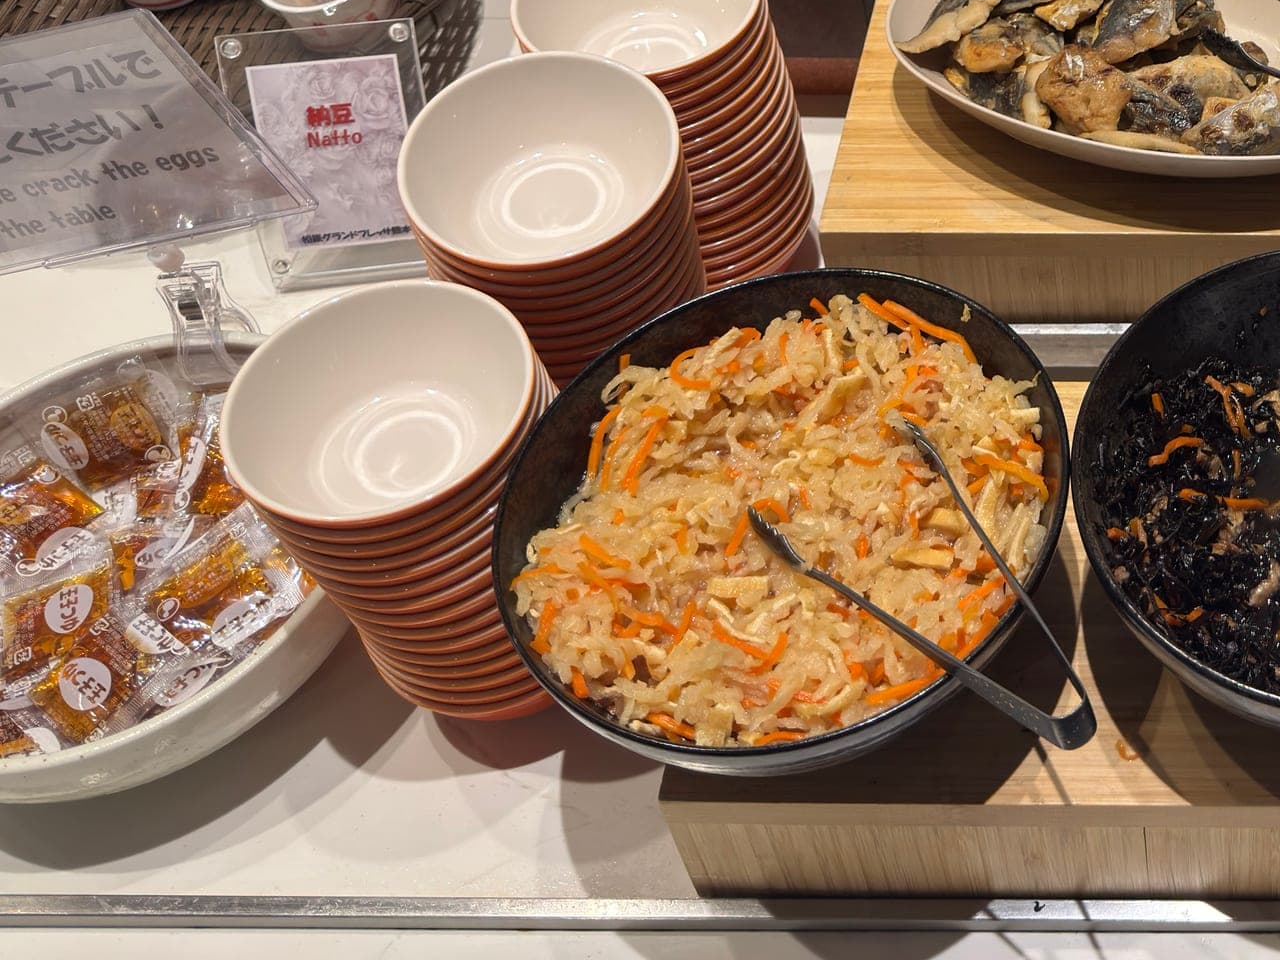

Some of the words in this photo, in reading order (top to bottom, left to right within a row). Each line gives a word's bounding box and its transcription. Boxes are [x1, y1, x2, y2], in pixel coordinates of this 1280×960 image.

[306, 102, 355, 127] 納豆
[306, 128, 363, 148] Natto
[22, 168, 99, 197] crack
[100, 160, 150, 181] the
[155, 146, 220, 172] eggs
[0, 218, 46, 239] the
[48, 203, 116, 228] table
